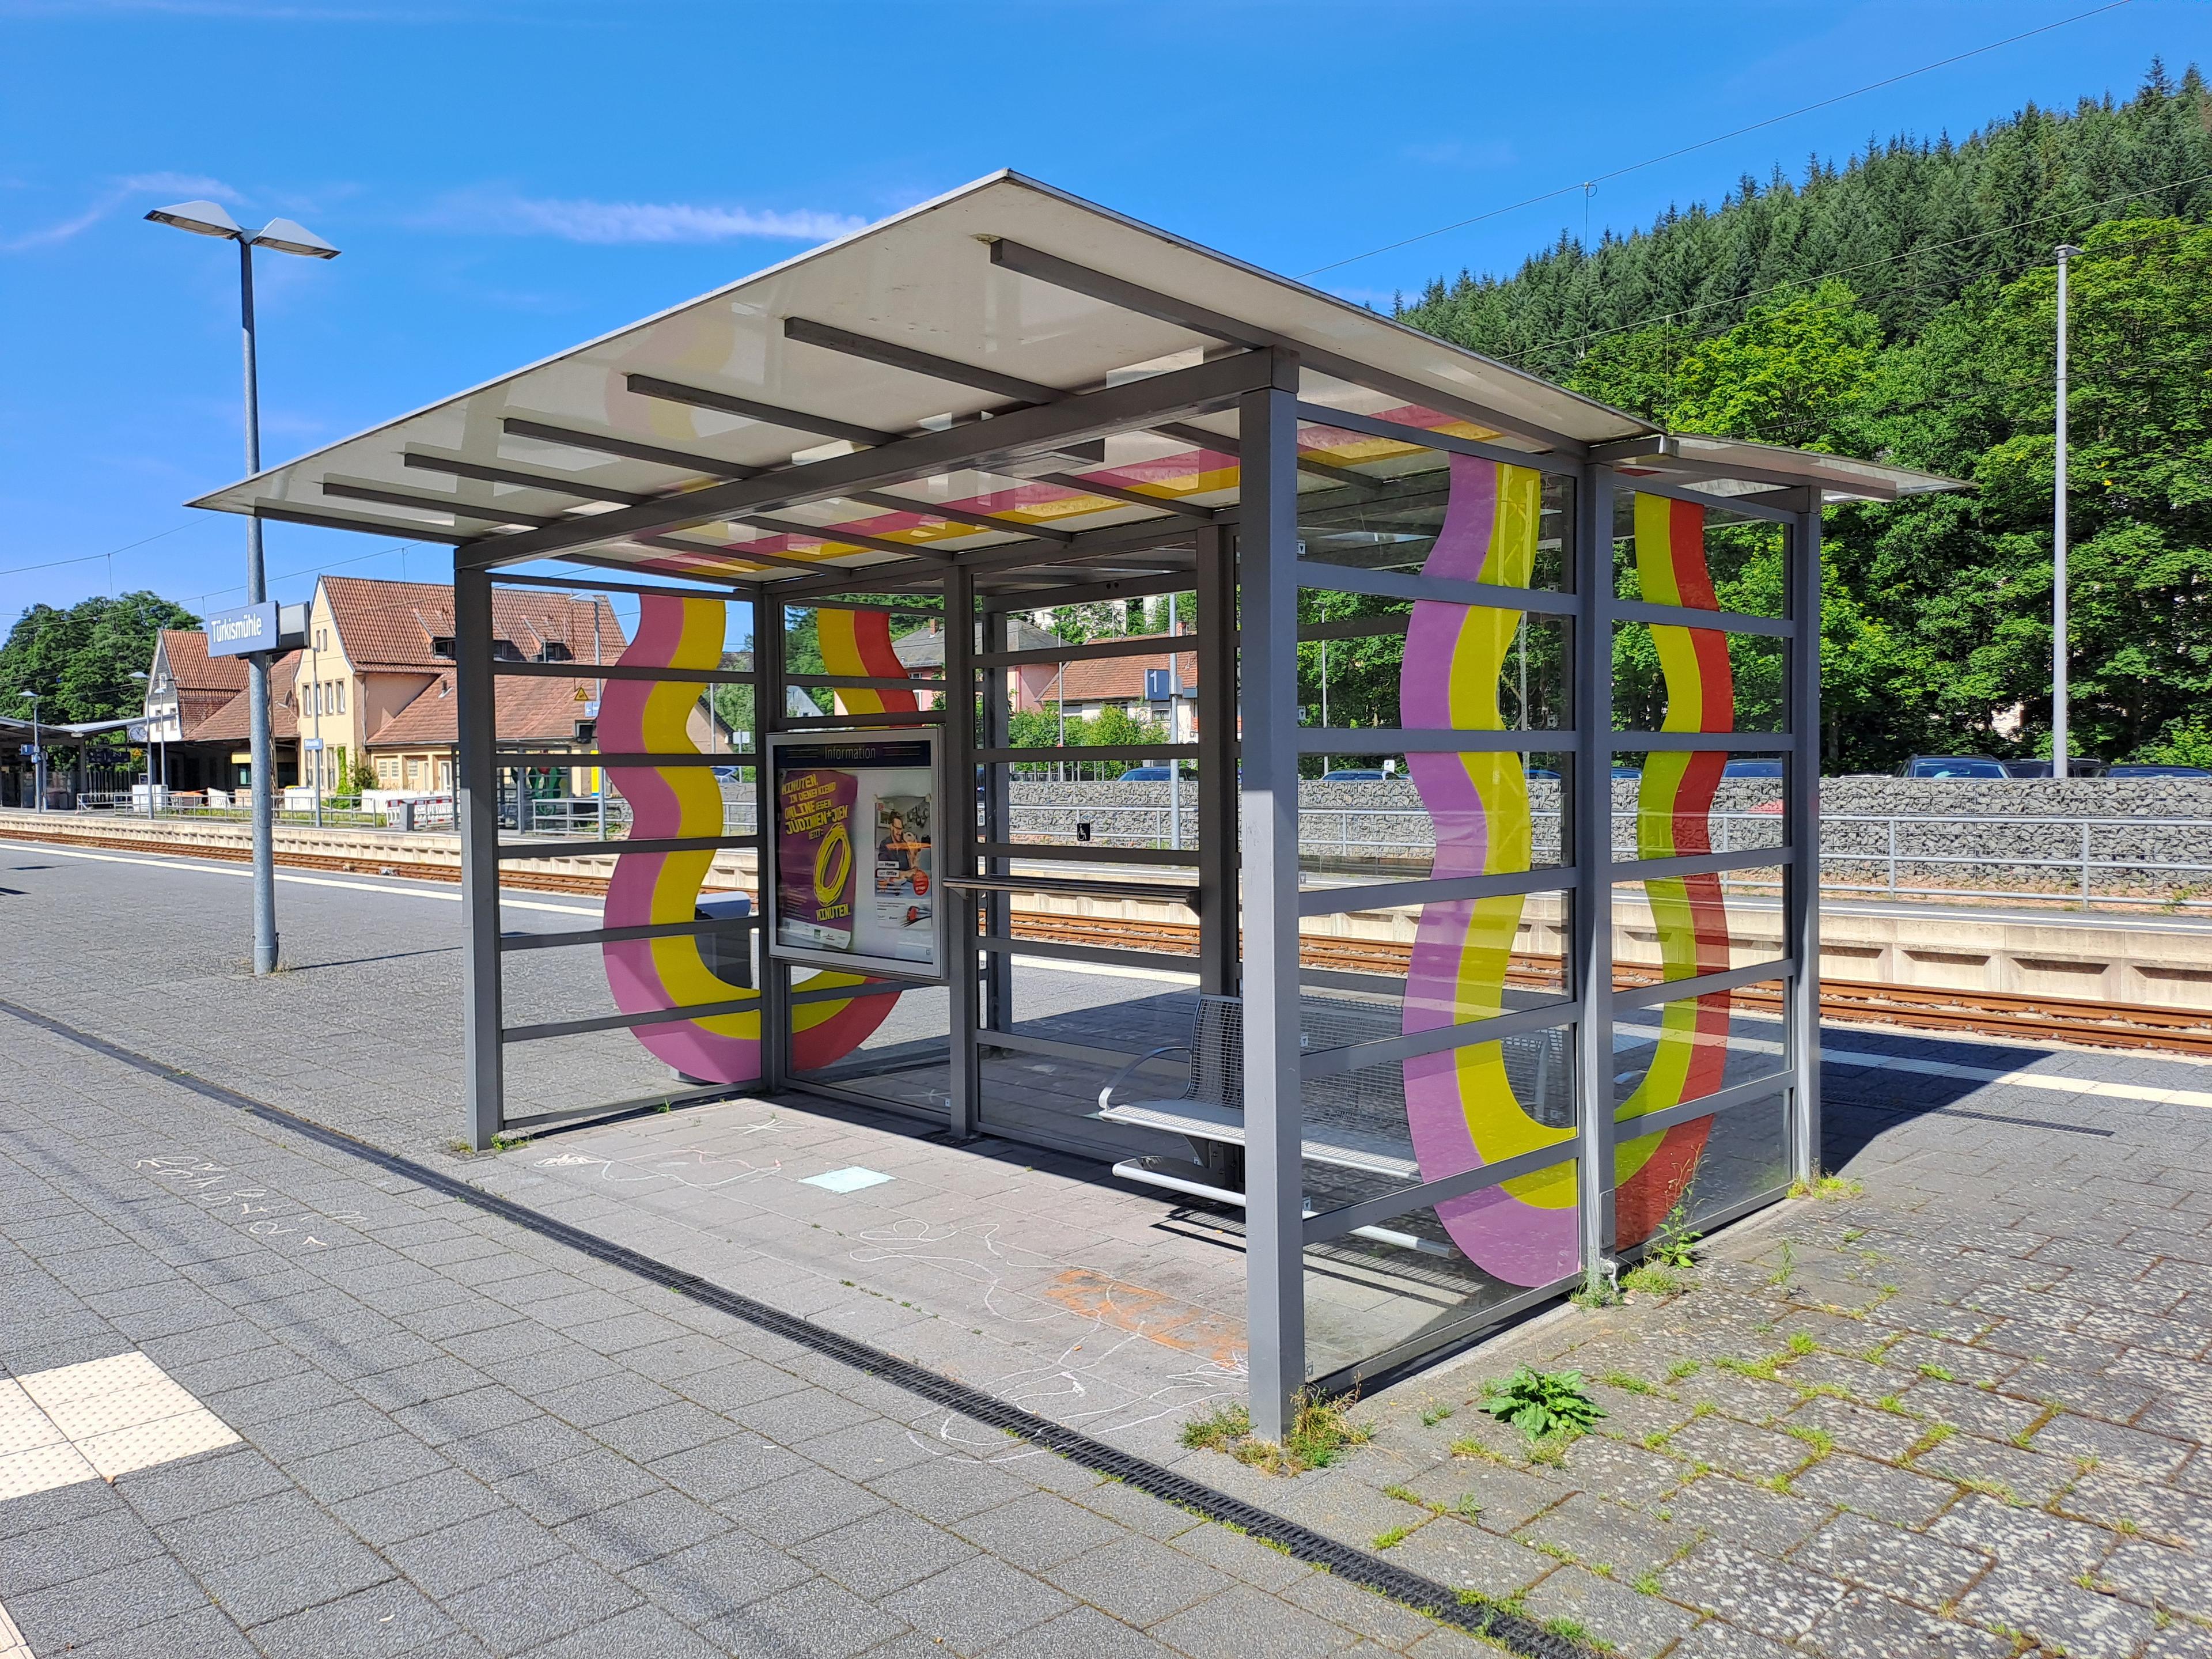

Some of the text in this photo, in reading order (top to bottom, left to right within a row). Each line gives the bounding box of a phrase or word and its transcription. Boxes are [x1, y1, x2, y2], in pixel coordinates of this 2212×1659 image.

[211, 613, 262, 643] Türkismühle
[1150, 671, 1158, 693] 1
[824, 746, 876, 760] Information
[785, 800, 816, 820] ONLINE
